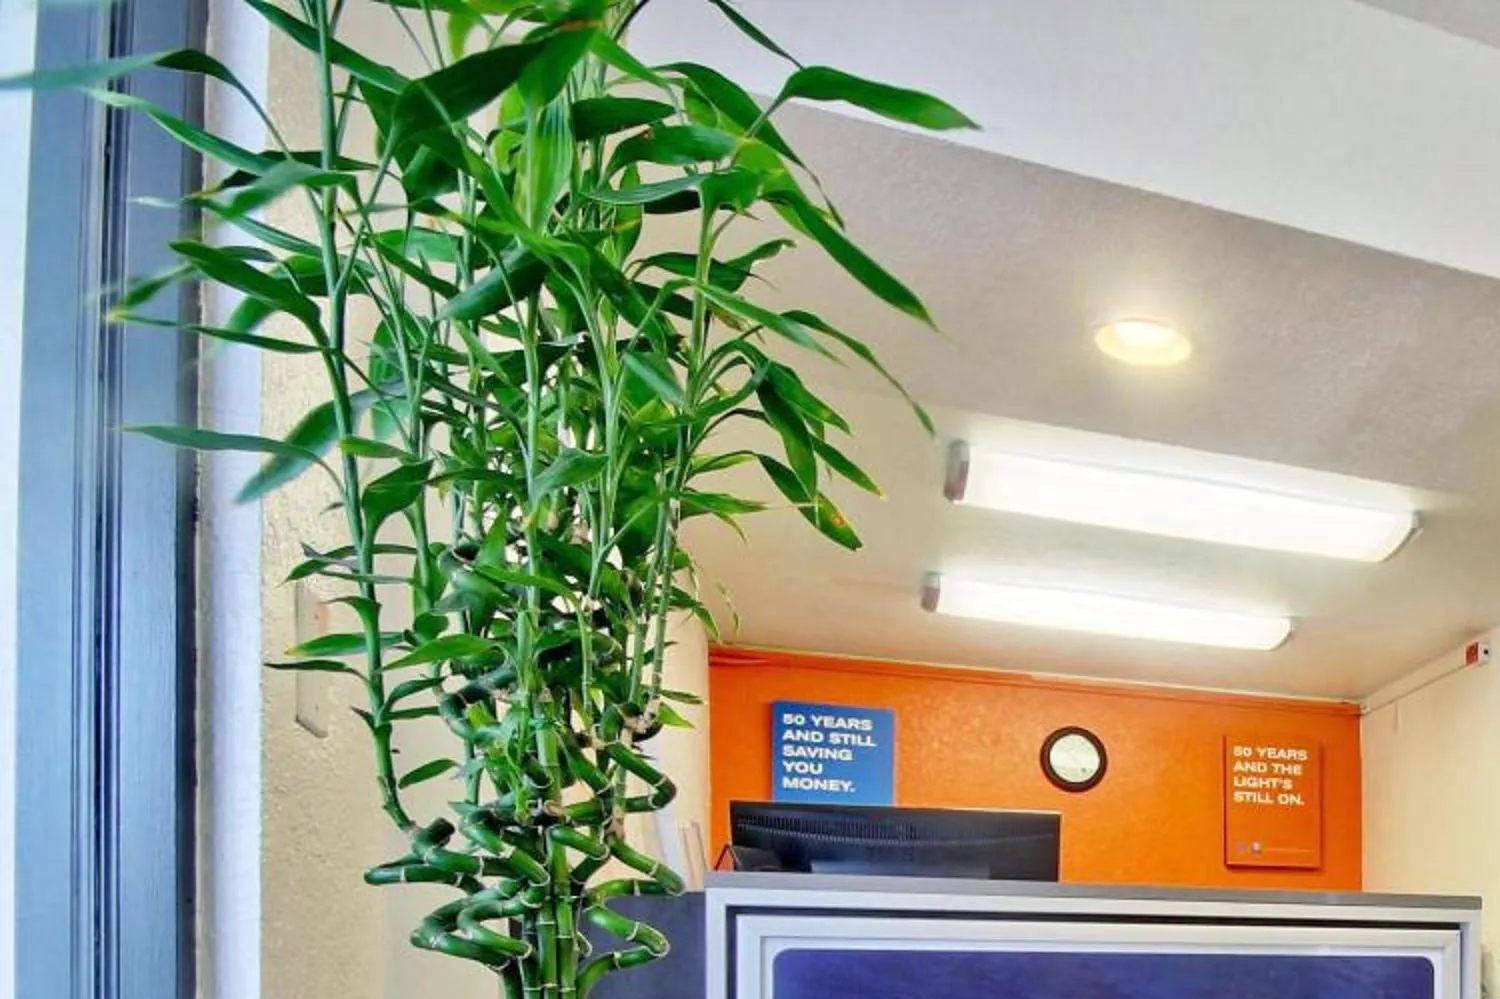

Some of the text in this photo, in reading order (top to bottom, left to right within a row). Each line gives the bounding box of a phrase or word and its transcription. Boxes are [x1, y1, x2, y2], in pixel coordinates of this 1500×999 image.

[783, 713, 873, 731] 50 YEARS
[782, 729, 877, 747] AND STILL
[782, 743, 854, 761] SAVING
[1233, 745, 1309, 761] 50 YEARS
[782, 760, 823, 775] YOU
[1233, 761, 1303, 775] AND THE
[782, 776, 856, 792] MONEY.
[1233, 776, 1293, 790] LIGHT'S
[1233, 791, 1305, 805] STILL ON.
